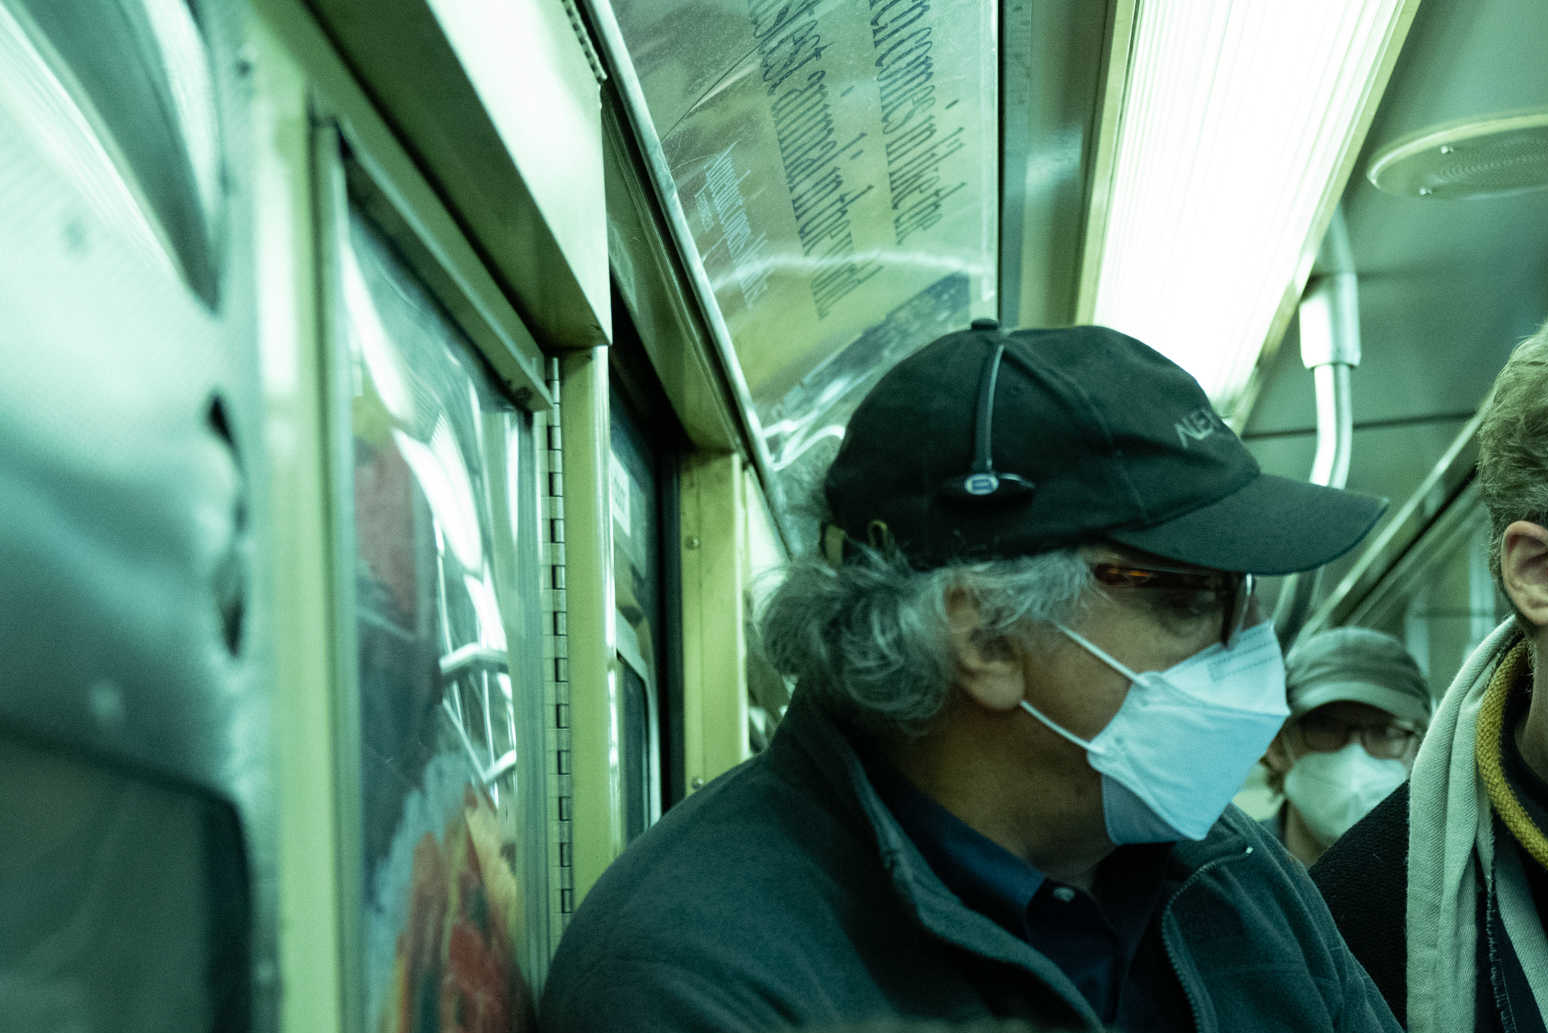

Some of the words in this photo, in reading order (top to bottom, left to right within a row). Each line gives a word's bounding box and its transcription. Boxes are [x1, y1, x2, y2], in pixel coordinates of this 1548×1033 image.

[875, 27, 936, 135] comes
[770, 70, 867, 194] animal
[886, 99, 960, 166] in
[889, 126, 966, 211] like
[694, 138, 752, 226] Aqueduct
[791, 150, 864, 222] in
[798, 184, 874, 257] the
[893, 181, 968, 246] the
